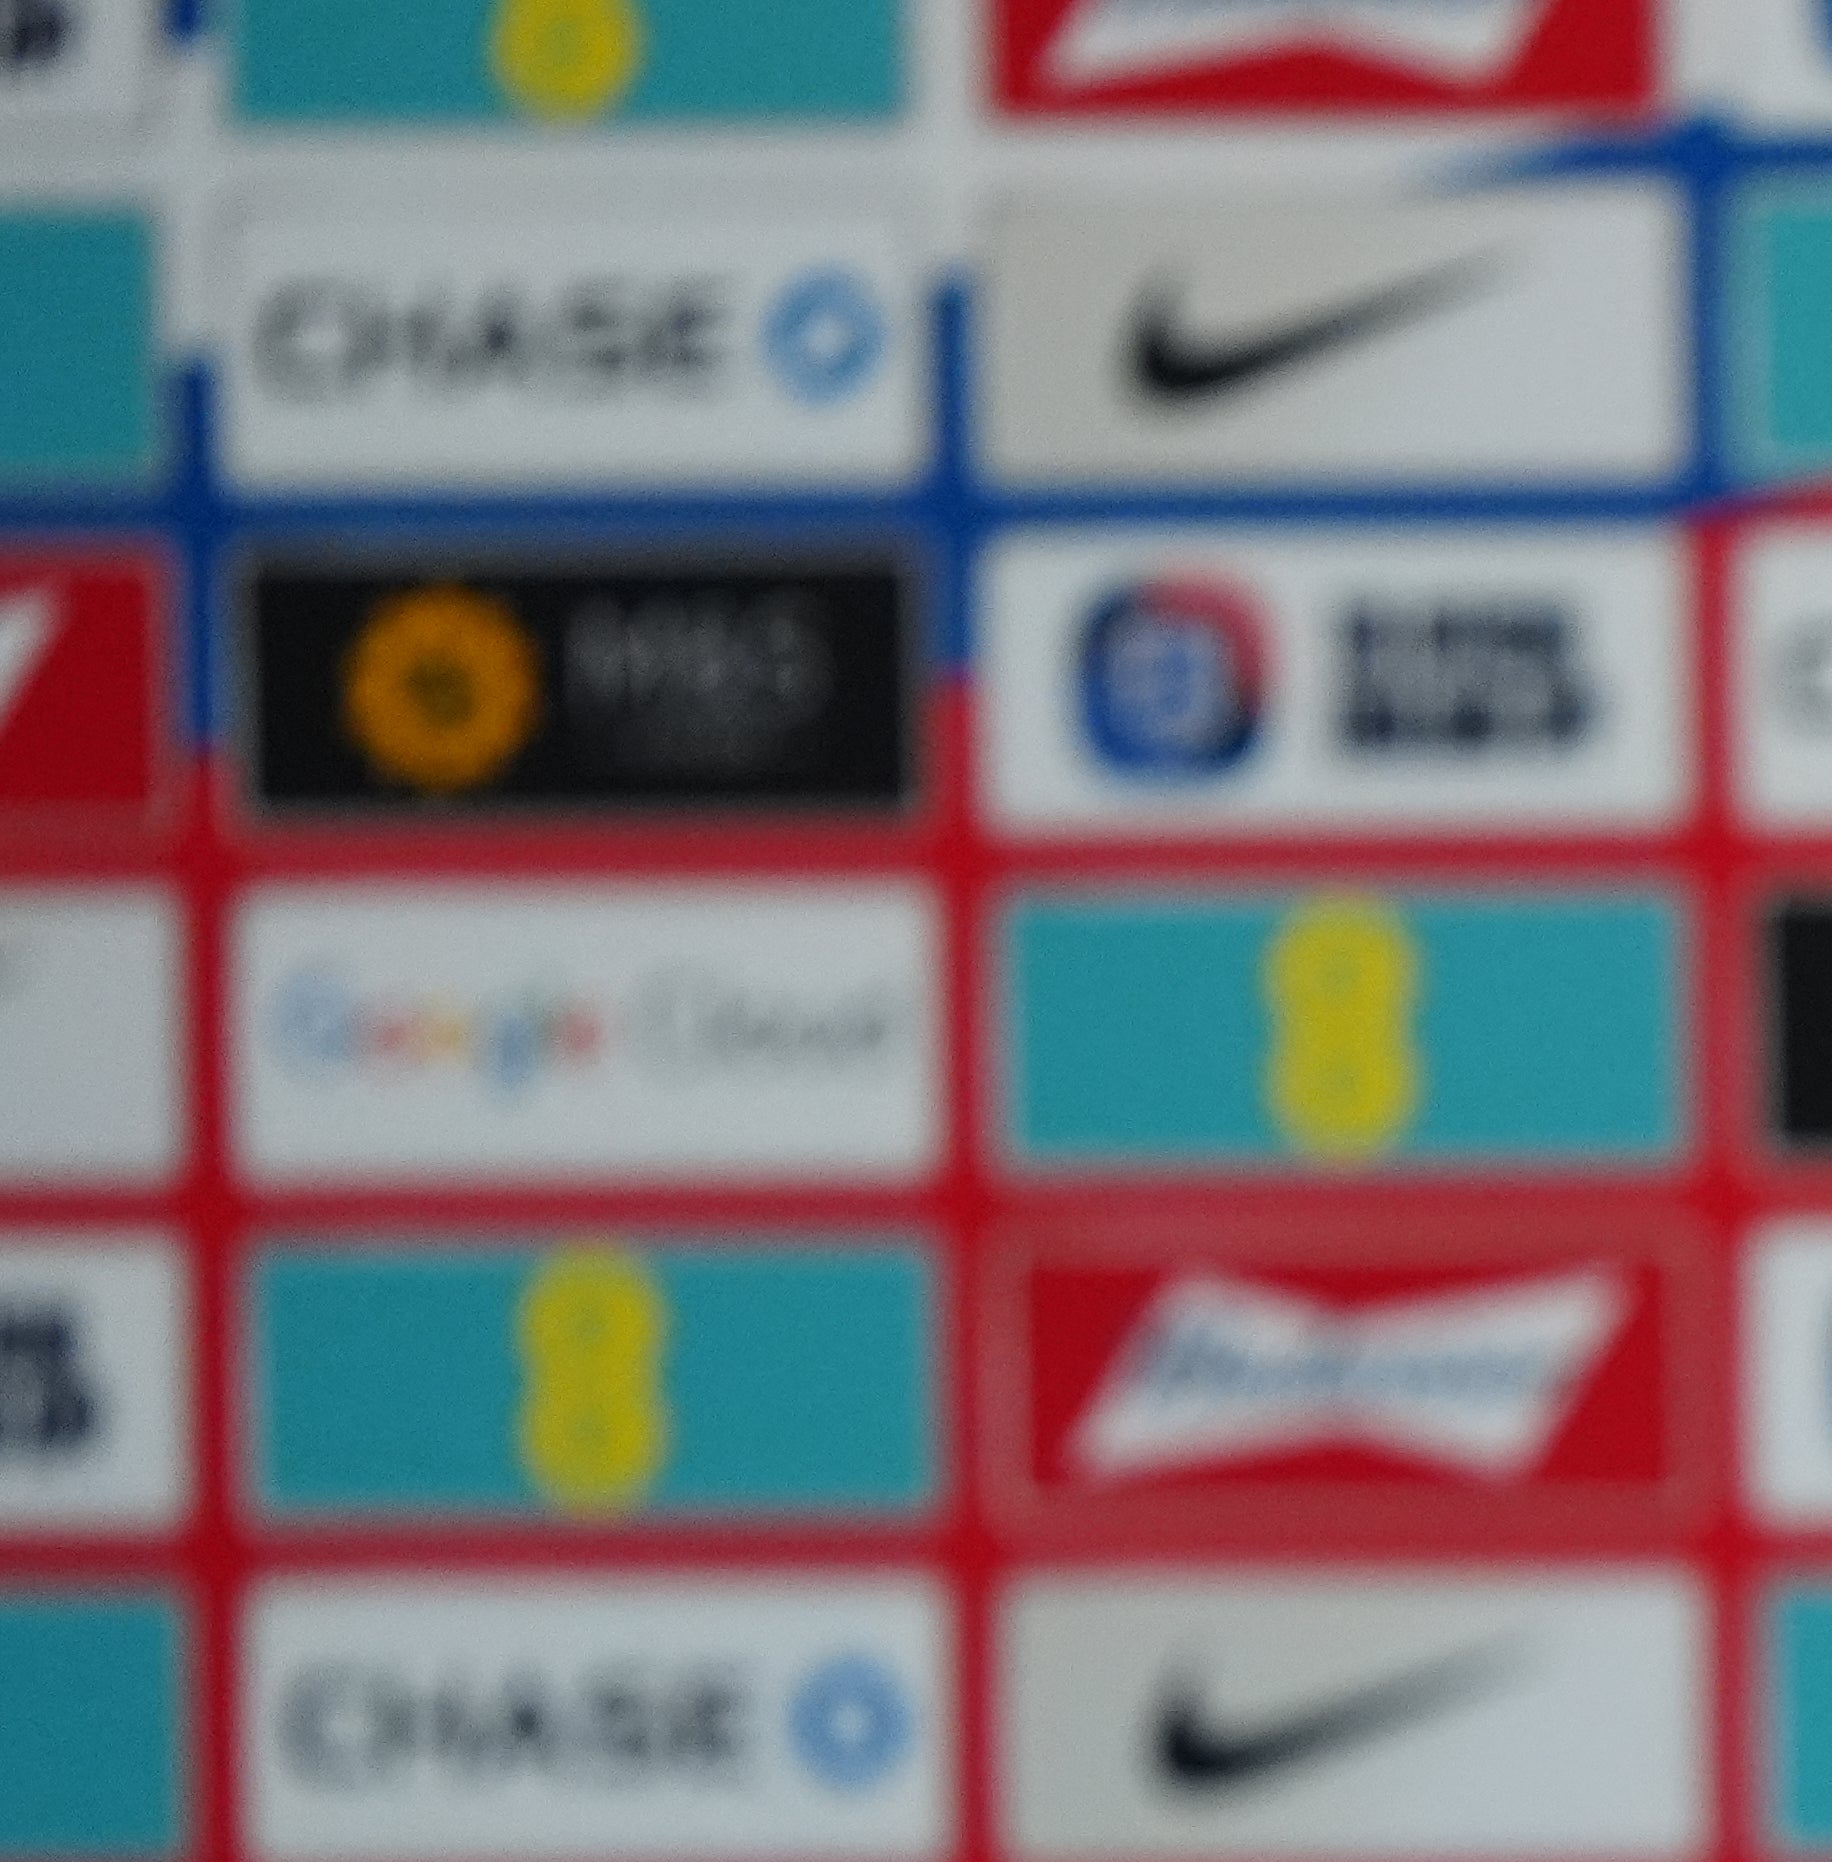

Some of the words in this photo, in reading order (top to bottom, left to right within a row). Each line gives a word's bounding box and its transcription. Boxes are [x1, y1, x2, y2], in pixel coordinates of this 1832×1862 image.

[252, 280, 728, 398] CHASE
[273, 968, 604, 1100] Google
[283, 1670, 750, 1781] CHASE
